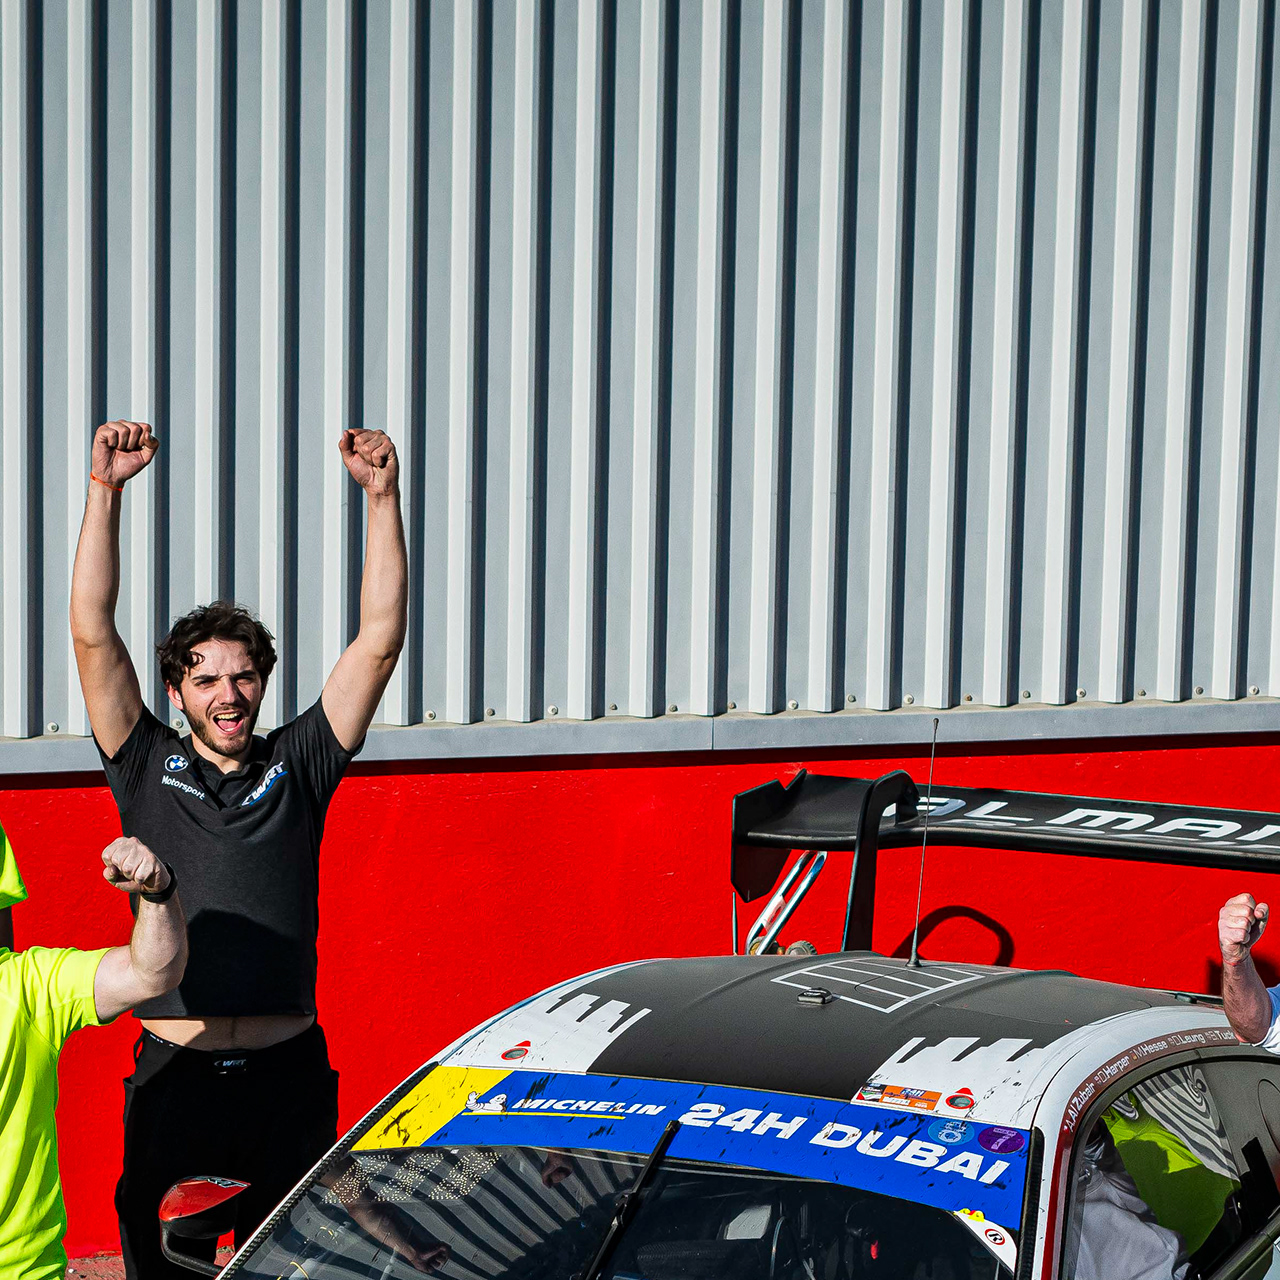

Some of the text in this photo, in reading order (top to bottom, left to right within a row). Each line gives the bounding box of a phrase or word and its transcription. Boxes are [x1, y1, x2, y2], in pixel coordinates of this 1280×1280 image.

[162, 774, 205, 800] Motorsport
[511, 1097, 667, 1117] MICHELIN
[678, 1102, 810, 1141] 24H
[809, 1121, 1012, 1186] DUBAI
